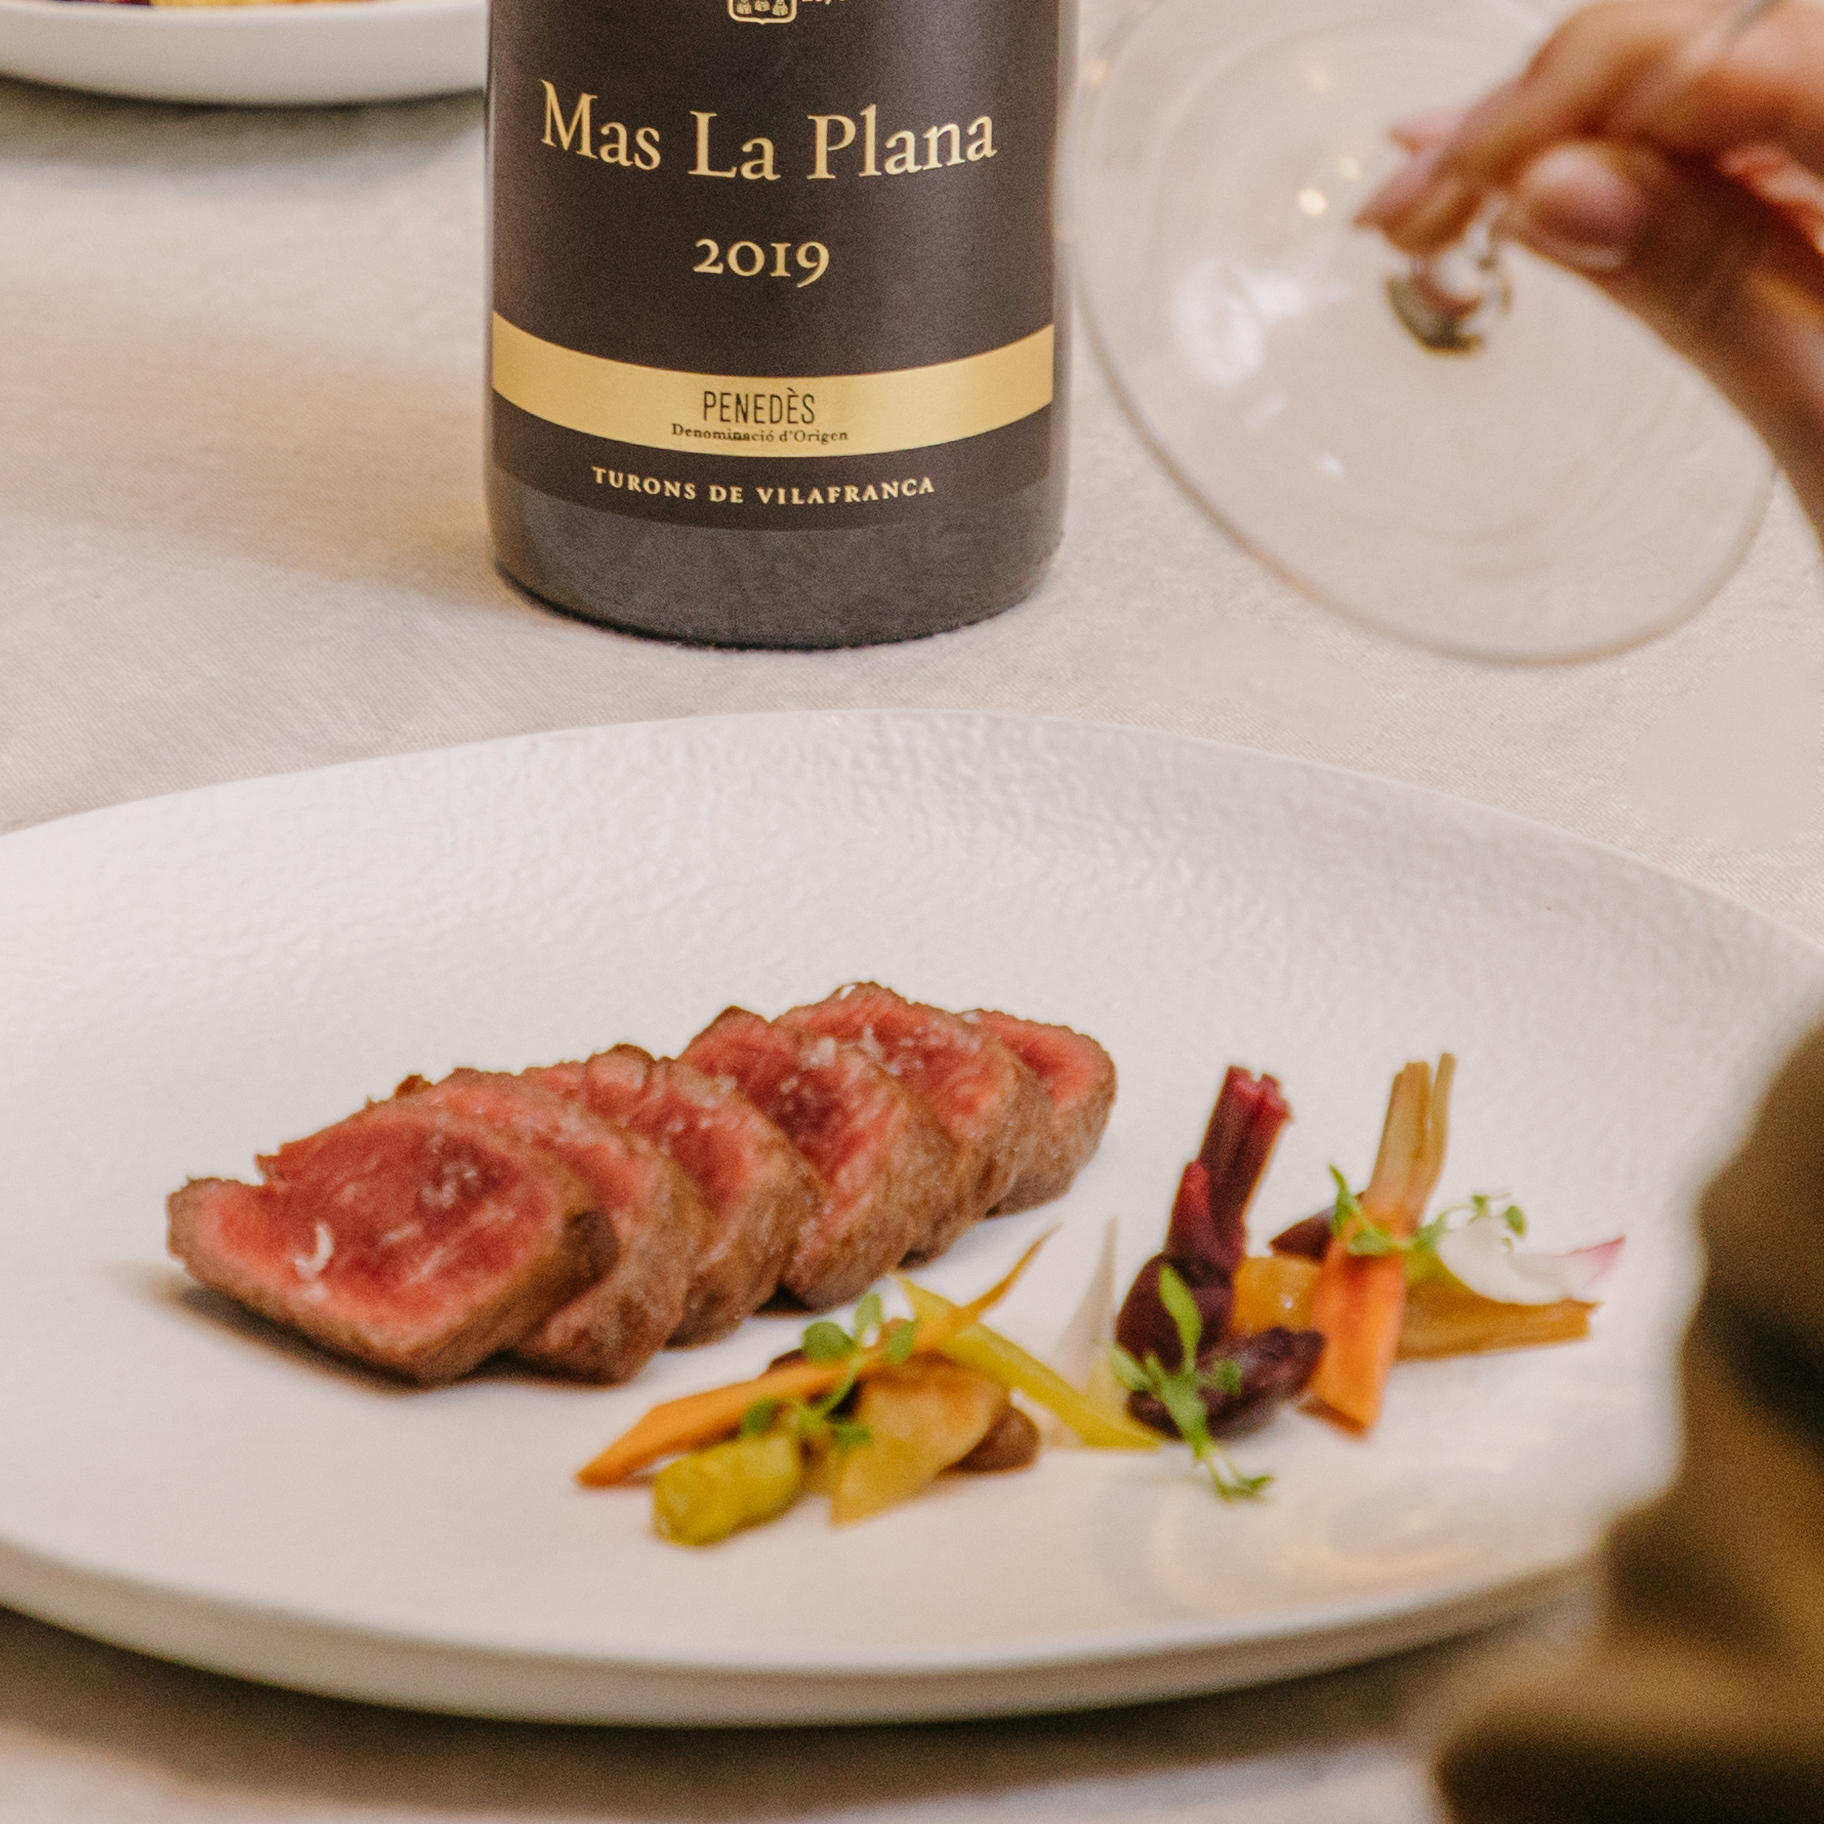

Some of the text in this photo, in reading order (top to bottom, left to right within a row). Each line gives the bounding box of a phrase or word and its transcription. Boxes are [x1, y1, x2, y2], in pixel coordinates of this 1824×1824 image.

[541, 79, 999, 181] Mas La Plana
[692, 238, 831, 288] 2019
[702, 387, 816, 426] PENEDÈS
[671, 423, 849, 446] Denominació d'Origen
[592, 466, 936, 505] TURONS DE VILAFRANCA
